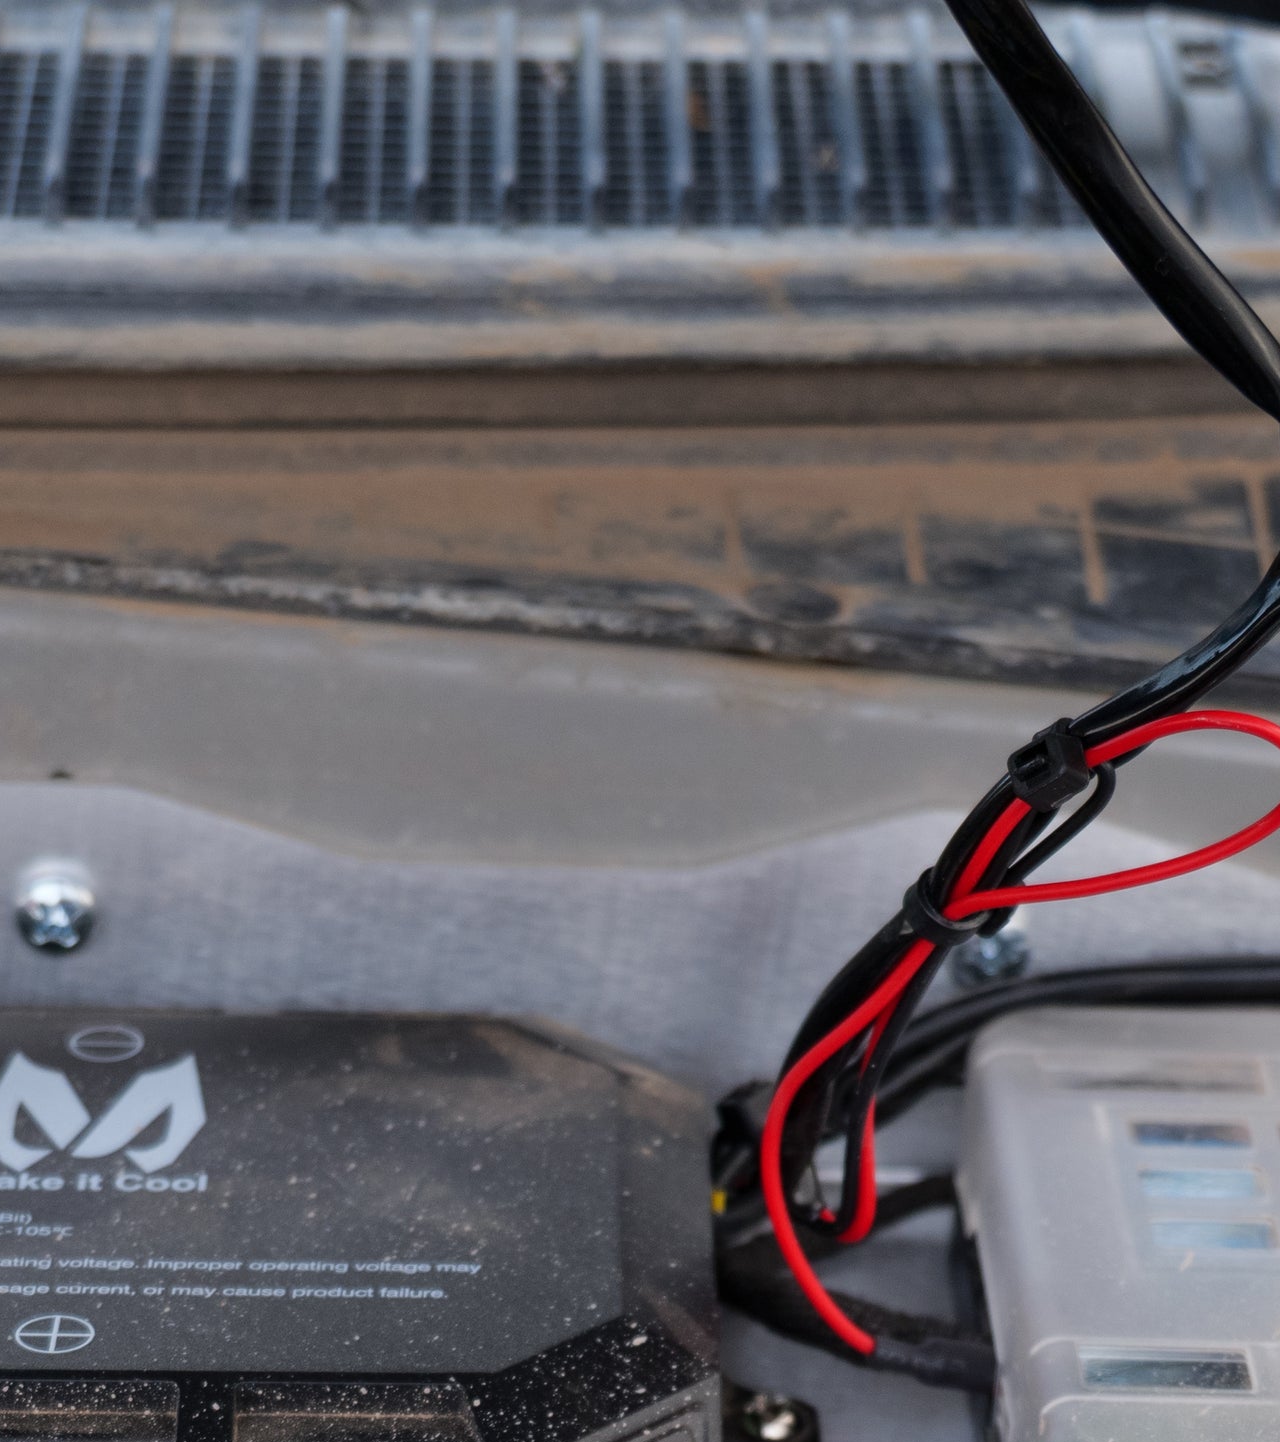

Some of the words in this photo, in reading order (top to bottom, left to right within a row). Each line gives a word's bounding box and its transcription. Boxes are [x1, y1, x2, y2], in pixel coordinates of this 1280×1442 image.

[114, 1173, 209, 1193] Cool
[146, 1258, 243, 1272] Improper
[248, 1260, 349, 1273] operating
[355, 1261, 432, 1275] voltage
[435, 1263, 482, 1275] may
[55, 1284, 136, 1297] current,
[143, 1285, 165, 1295] or
[171, 1286, 217, 1298] may
[222, 1286, 286, 1297] cause
[292, 1286, 374, 1299] product
[379, 1287, 449, 1299] failure.
